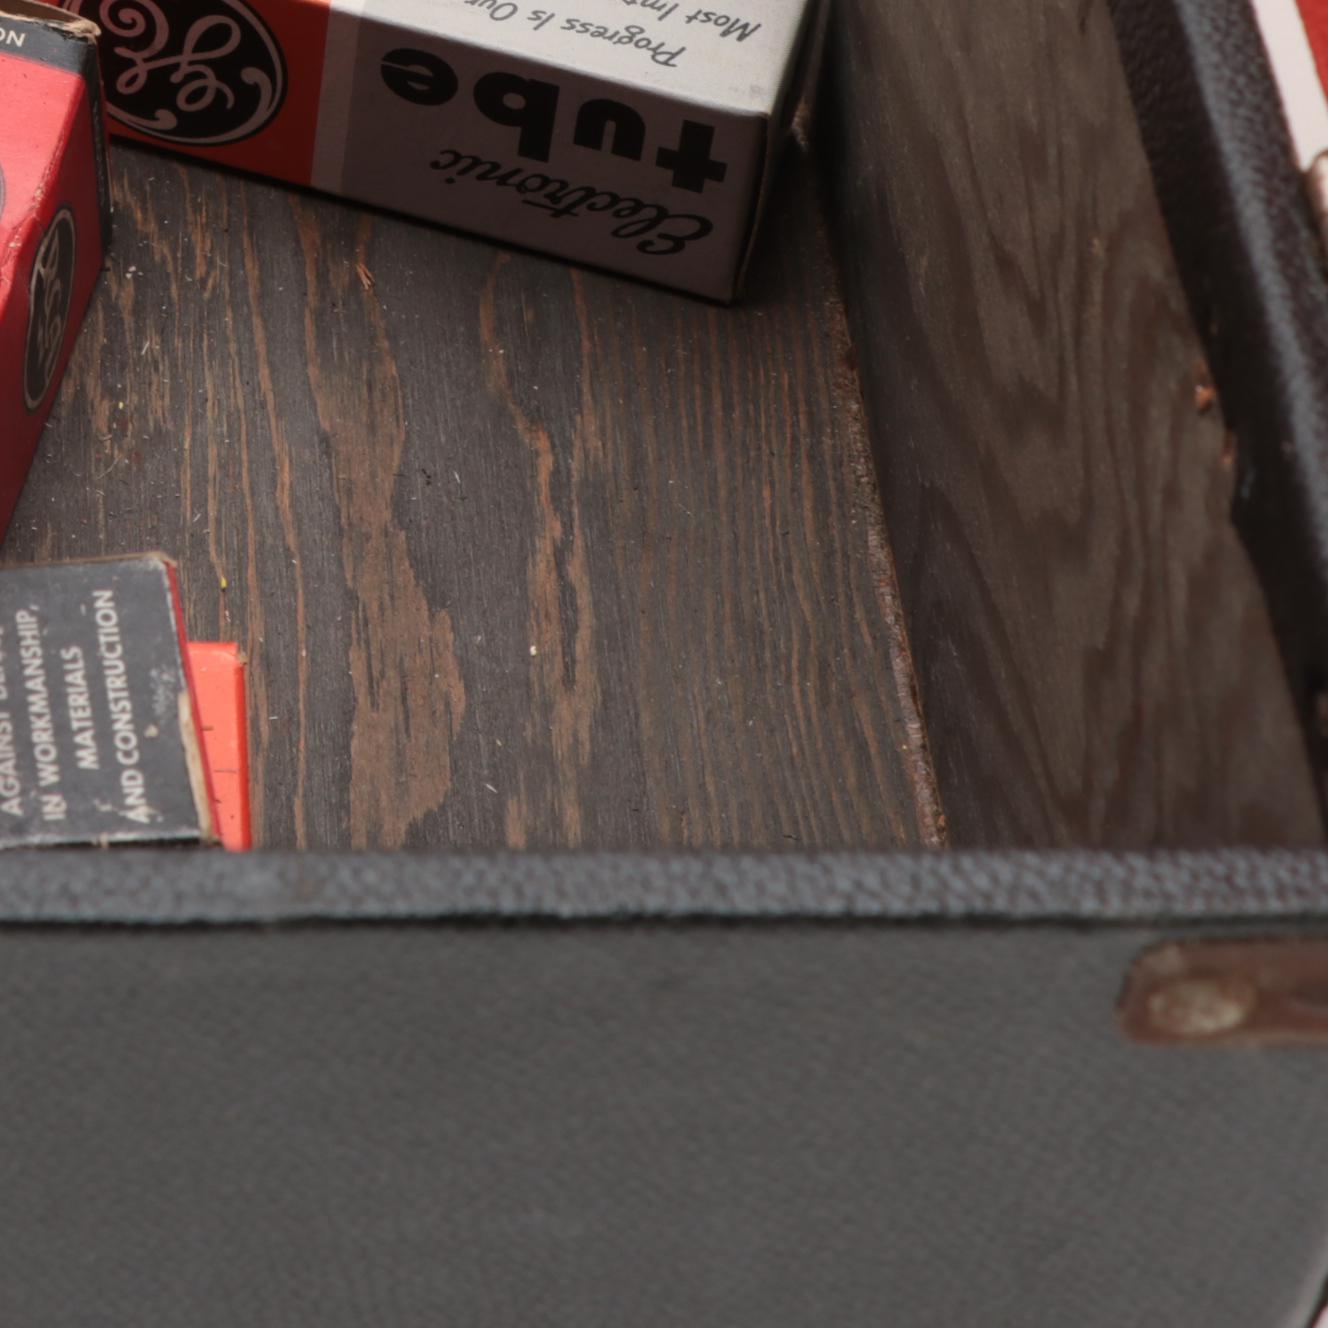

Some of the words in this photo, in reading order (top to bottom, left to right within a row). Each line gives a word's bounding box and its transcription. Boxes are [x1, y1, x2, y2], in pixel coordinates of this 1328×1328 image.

[527, 8, 556, 32] Is
[561, 17, 687, 68] Progress
[685, 7, 762, 43] Most
[380, 47, 728, 194] tube
[429, 148, 714, 256] Electronic
[93, 589, 140, 765] CONSTRUCTION
[60, 644, 100, 770] MATERIALS
[41, 795, 67, 822] IN
[119, 770, 151, 823] AND
